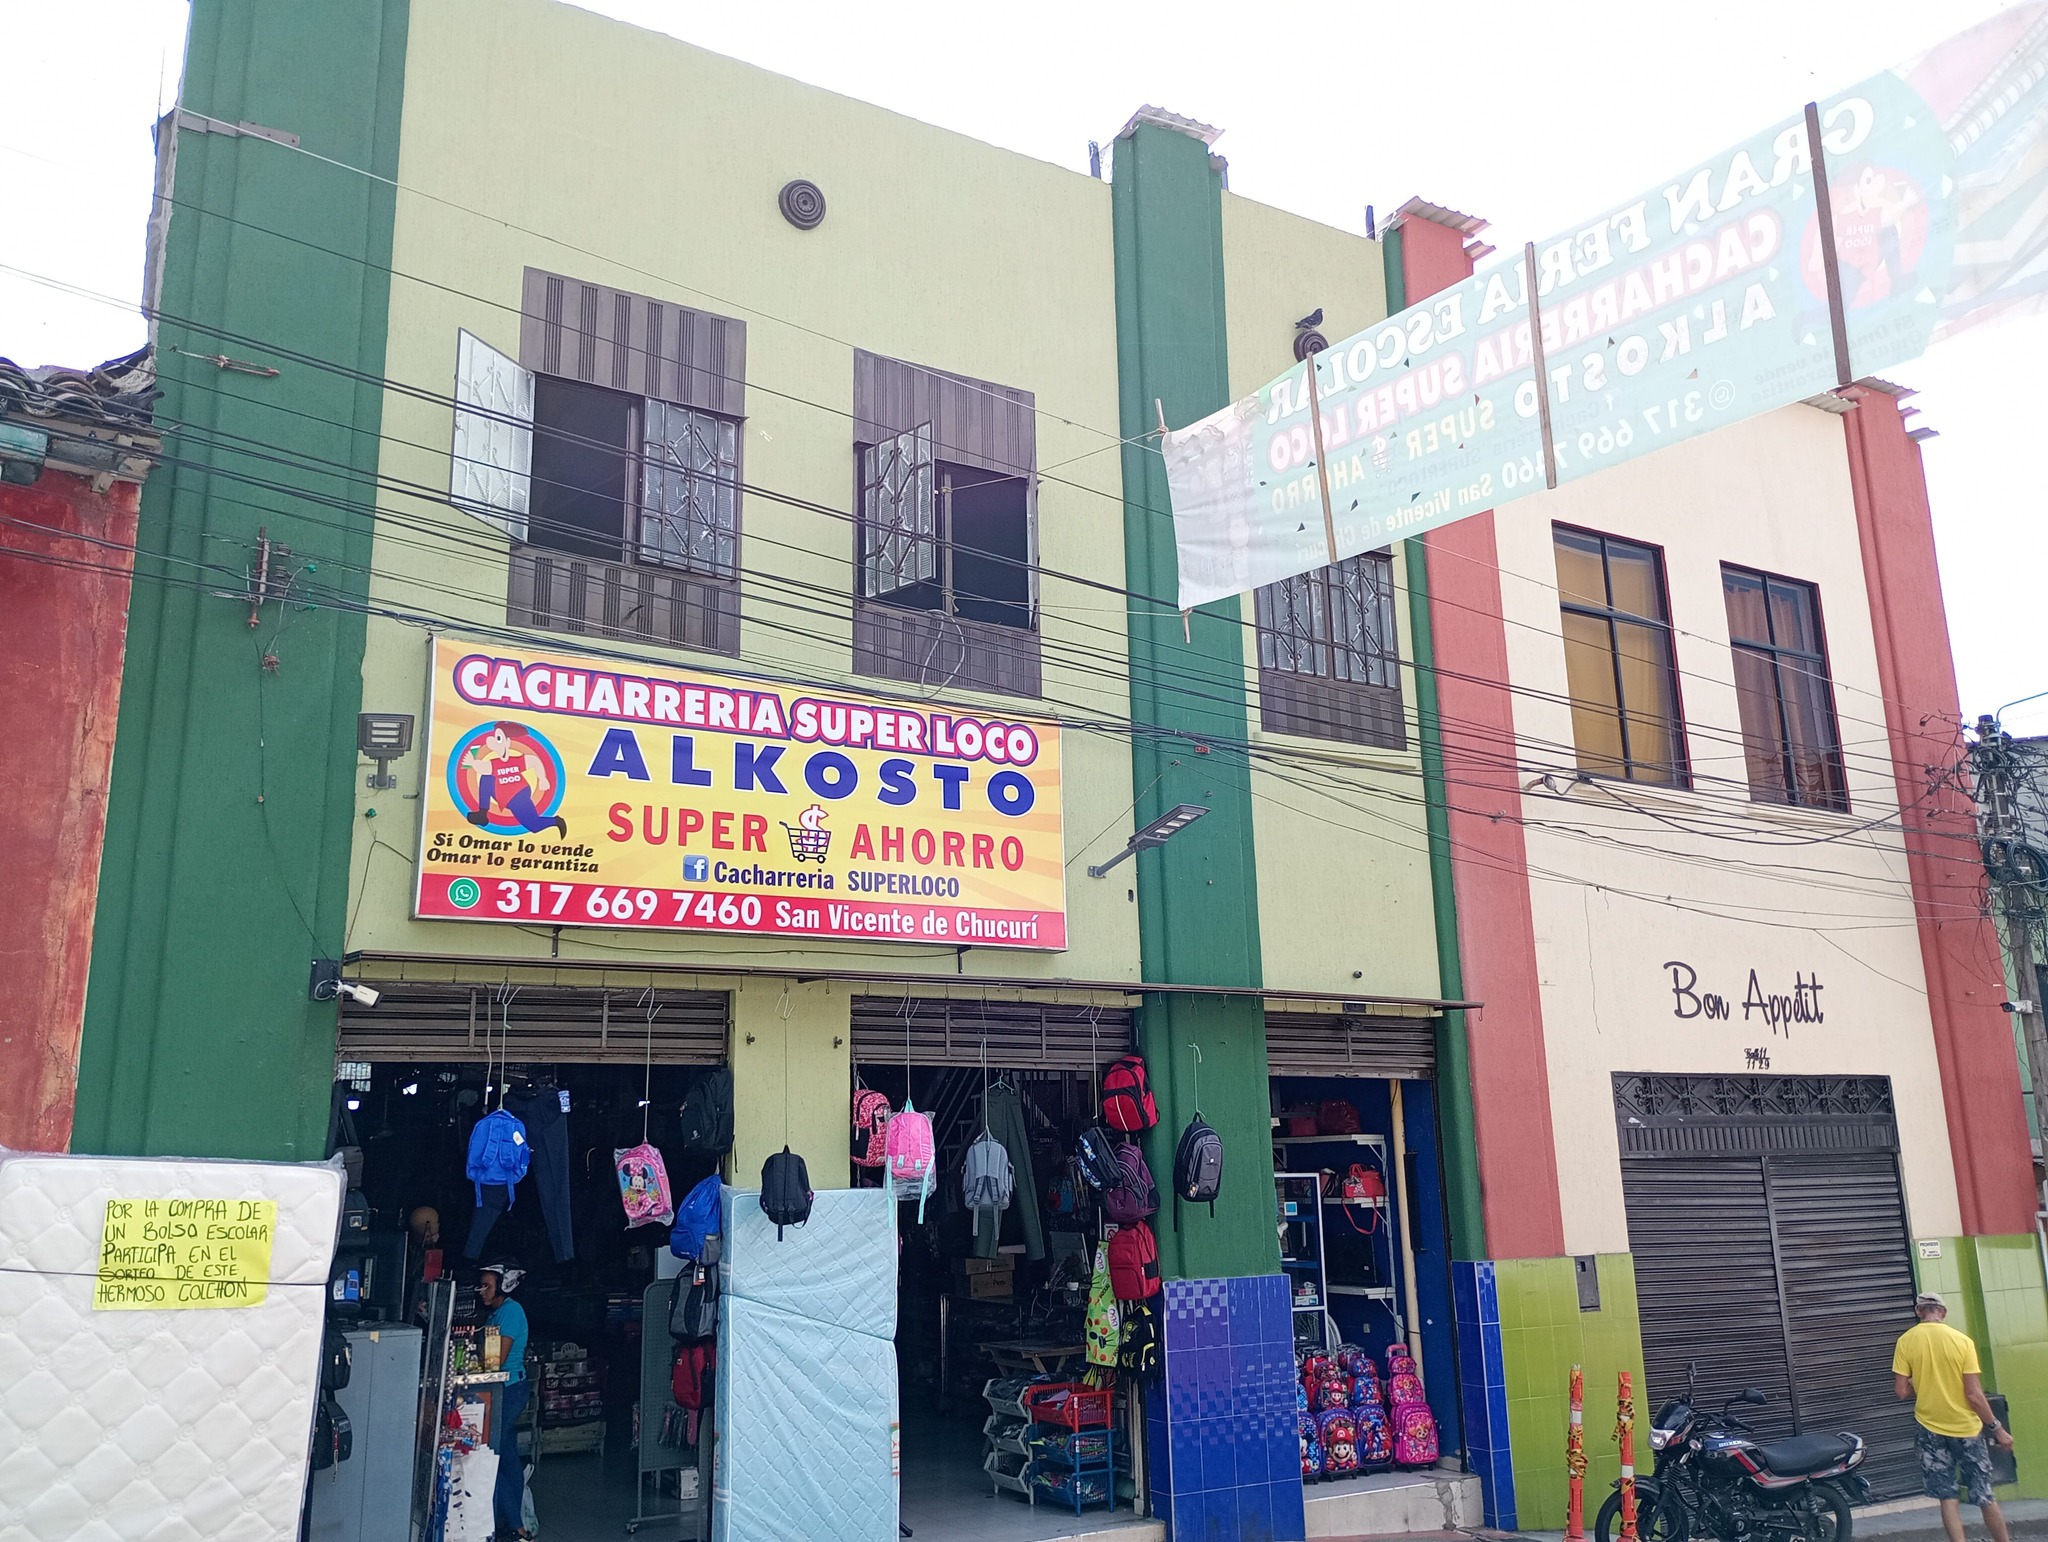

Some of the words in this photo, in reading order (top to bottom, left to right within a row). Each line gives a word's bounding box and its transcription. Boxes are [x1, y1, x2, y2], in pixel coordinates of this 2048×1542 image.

[456, 657, 787, 737] CACHARRERIA
[794, 702, 924, 753] SUPER
[932, 717, 1038, 764] LOCO
[497, 766, 520, 776] SUPER
[586, 727, 1036, 817] ALKOSTO
[433, 833, 454, 847] Si
[458, 835, 512, 852] Omar
[518, 839, 535, 853] lo
[541, 844, 594, 858] vende
[607, 802, 768, 853] SUPER
[850, 822, 1024, 872] AHORRO
[426, 848, 481, 865] Omar
[487, 852, 505, 866] lo
[510, 857, 599, 873] garantiza
[713, 861, 834, 891] Cacharreria
[848, 871, 960, 898] SUPERLOCO
[496, 881, 574, 916] 317
[586, 887, 659, 921] 669
[672, 891, 762, 927] 7460
[775, 901, 820, 929] San
[828, 904, 915, 935] Vicente
[921, 910, 949, 936] de
[955, 911, 1039, 941] Chucurí
[1663, 961, 1729, 1020] Bon
[106, 1200, 133, 1222] POR
[144, 1200, 160, 1217] LA
[168, 1199, 227, 1221] COMPRA
[236, 1200, 262, 1221] DE
[104, 1223, 126, 1242] UN
[142, 1222, 198, 1241] BOLSO
[206, 1225, 268, 1242] ESCOLAR
[102, 1243, 176, 1266] PARTICIPA
[189, 1246, 211, 1263] EN
[219, 1246, 237, 1261] EL
[174, 1264, 194, 1280] DE
[203, 1264, 240, 1277] ESTE
[97, 1283, 165, 1303] HERMOSO
